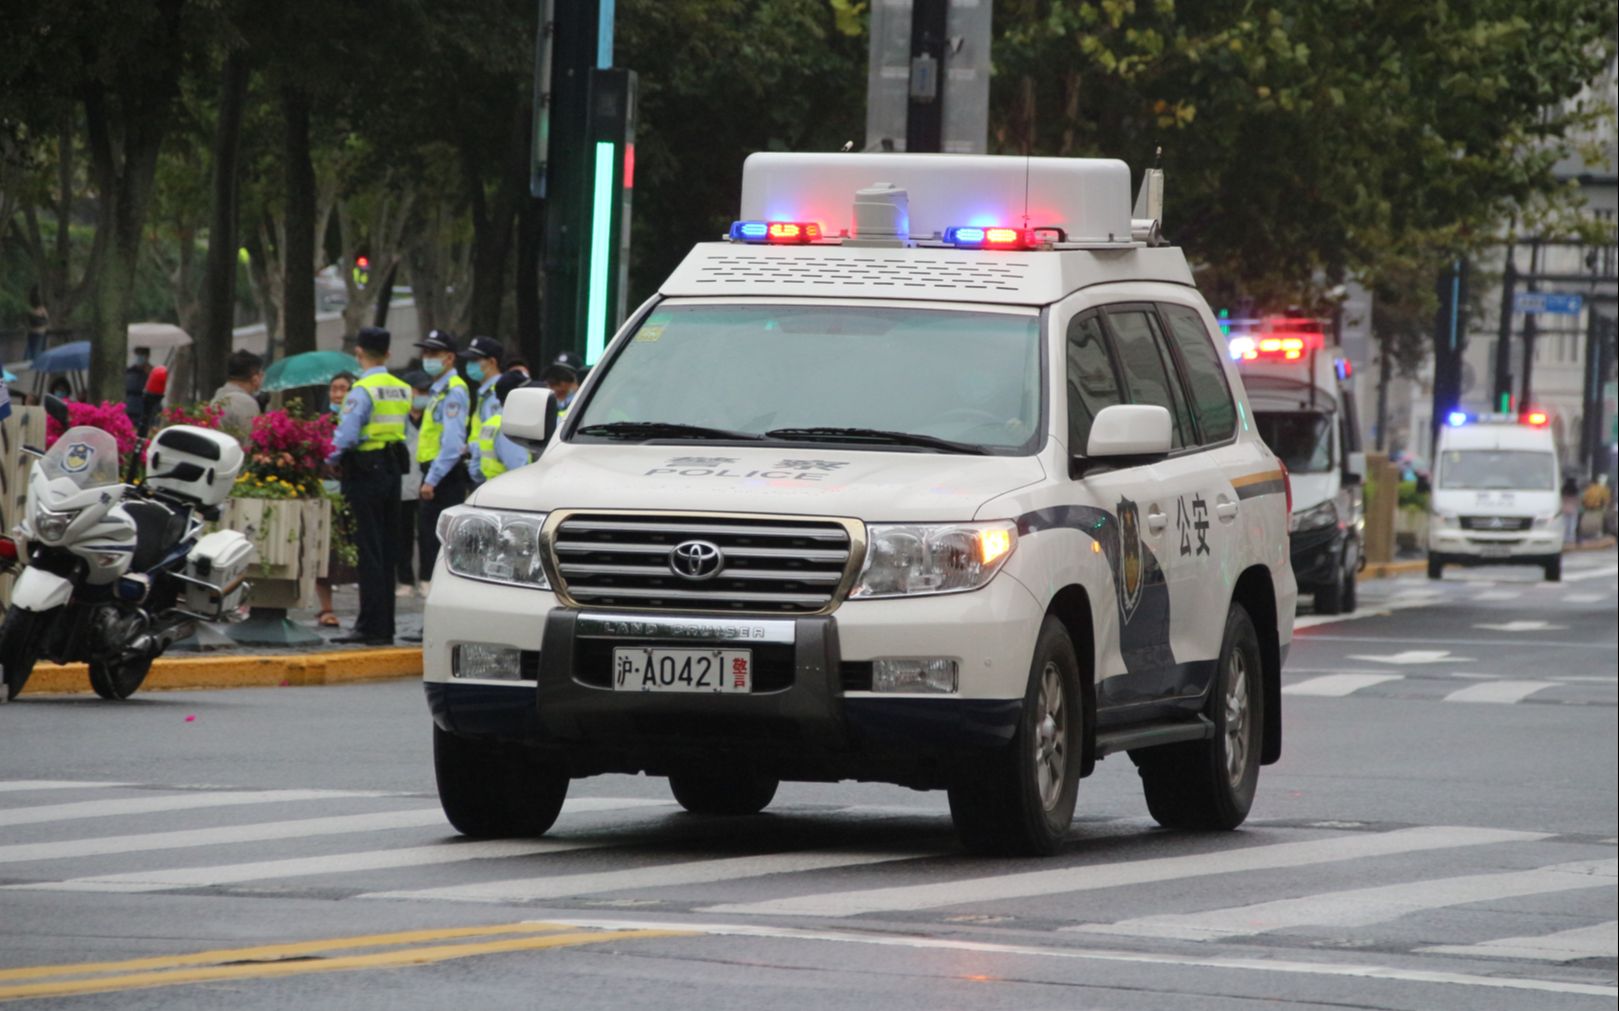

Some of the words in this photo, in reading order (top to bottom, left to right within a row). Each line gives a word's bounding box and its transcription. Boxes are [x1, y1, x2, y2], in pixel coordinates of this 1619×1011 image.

[644, 468, 829, 481] POLICE
[1176, 492, 1210, 556] 公安
[603, 621, 658, 635] LAND
[671, 623, 765, 638] CRUISER
